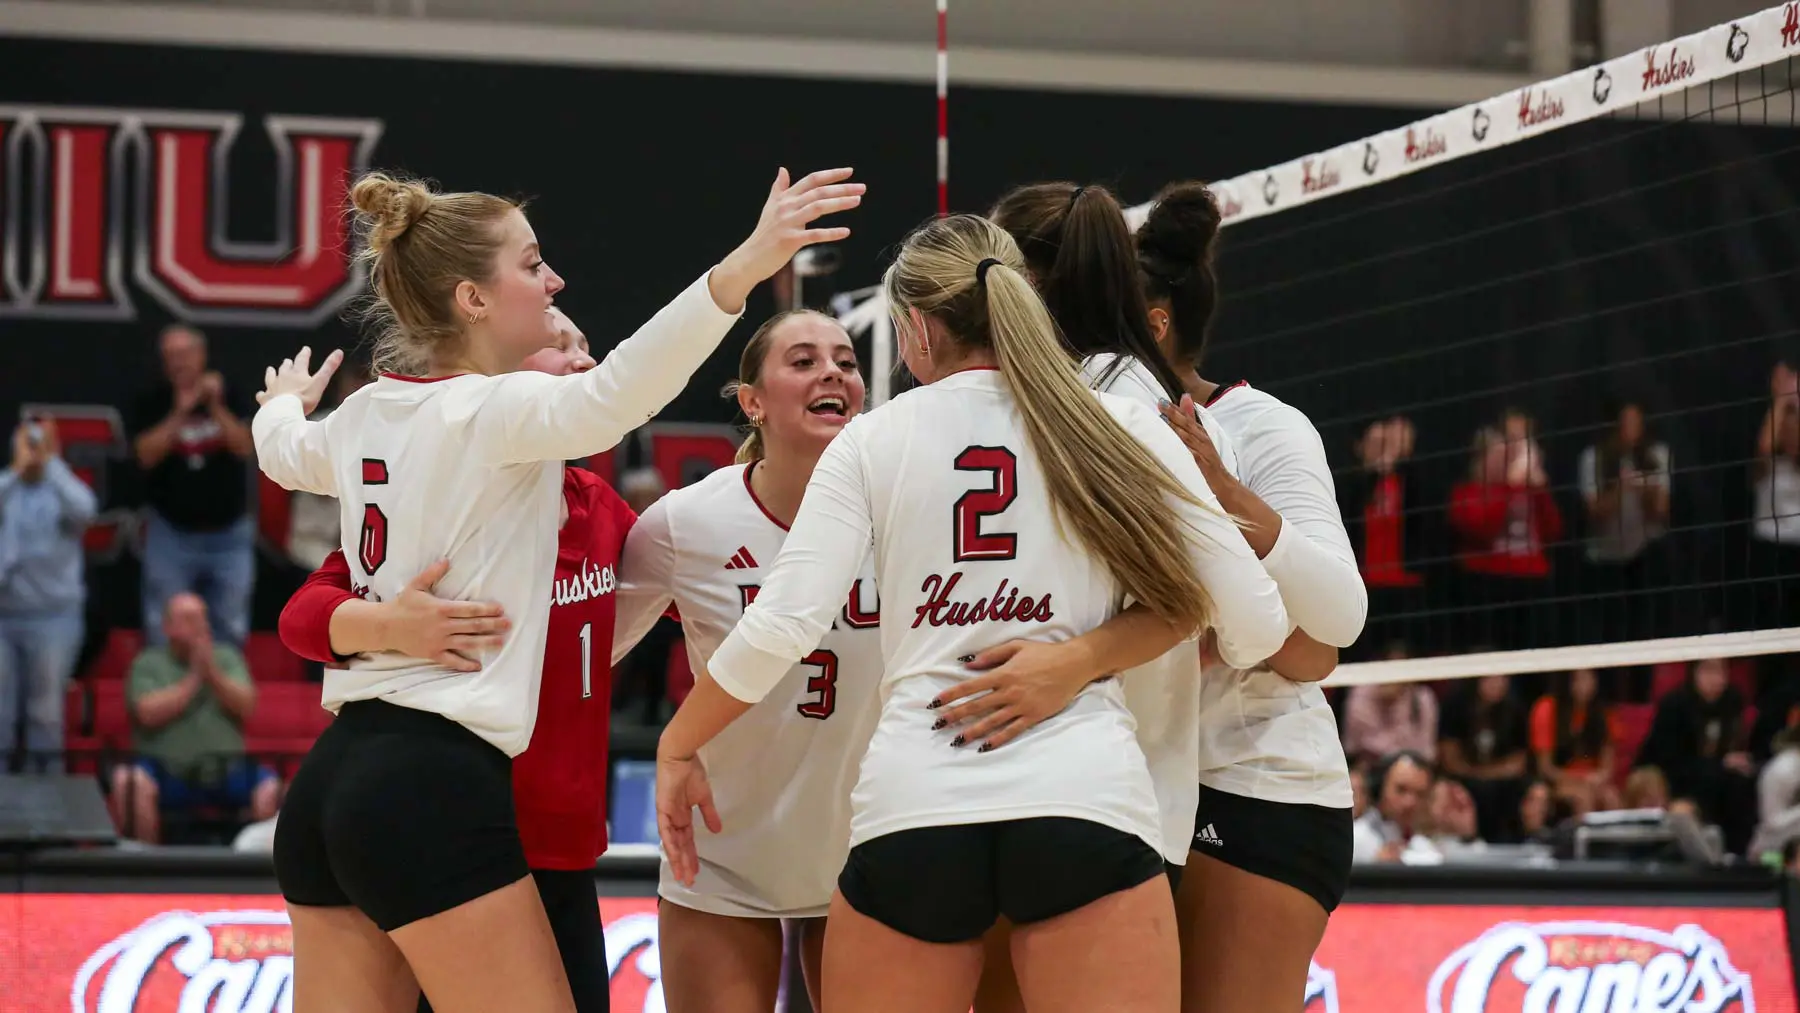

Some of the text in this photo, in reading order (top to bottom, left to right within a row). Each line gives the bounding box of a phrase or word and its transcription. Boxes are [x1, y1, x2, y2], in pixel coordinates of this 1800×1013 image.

[1642, 46, 1695, 91] Huskies
[1518, 87, 1564, 129] Huskies
[0, 102, 383, 327] IU
[953, 444, 1018, 564] 2
[551, 556, 617, 608] uskies
[910, 571, 1055, 629] Huskies
[579, 621, 592, 699] 1
[797, 648, 839, 721] 3
